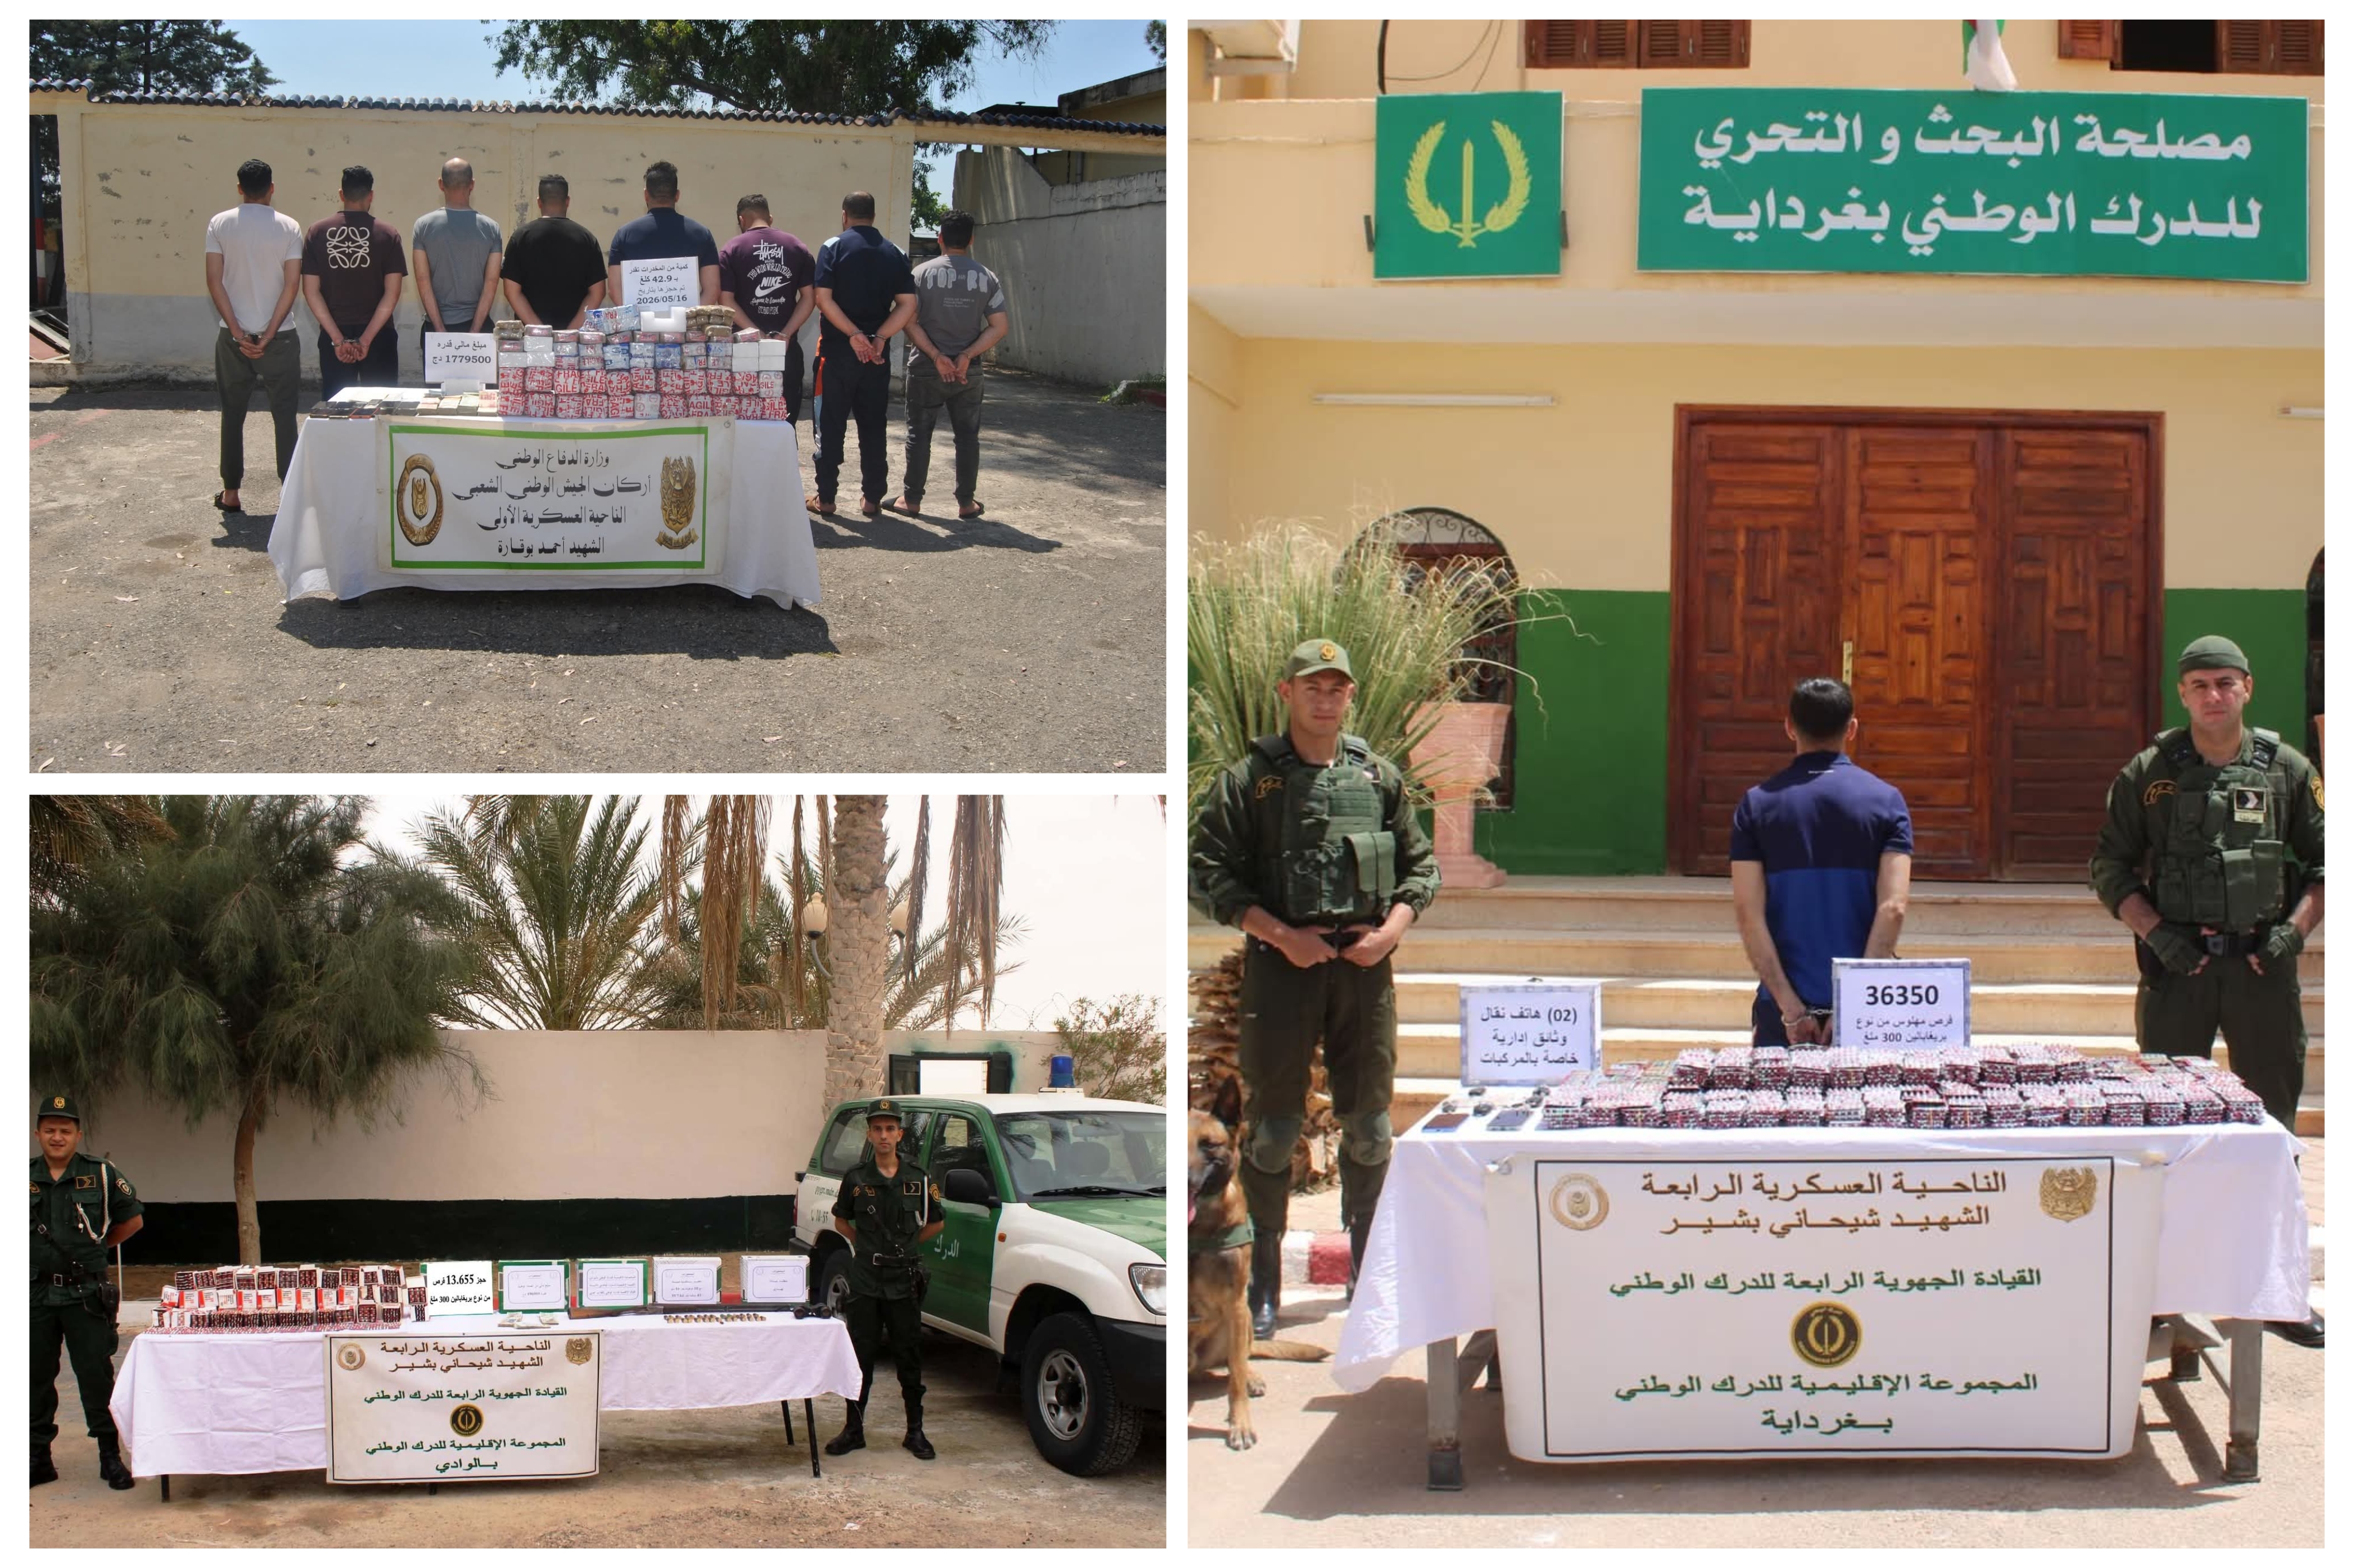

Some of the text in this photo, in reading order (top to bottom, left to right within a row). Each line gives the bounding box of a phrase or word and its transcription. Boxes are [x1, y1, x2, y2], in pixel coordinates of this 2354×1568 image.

[1695, 104, 2251, 169] مصلحة البحث و التحري
[1683, 186, 2262, 256] للدرك الوطني بغرداية
[640, 276, 650, 286] كلغ
[760, 276, 783, 287] NIKE
[636, 294, 687, 305] 2026/05/16
[638, 287, 656, 296] بتاريخ
[437, 340, 486, 350] مبلغ مالي قدره
[432, 355, 491, 364] 1779500 دج
[495, 448, 609, 473] وزارة الدفاع الوطني
[451, 476, 651, 501] أركان الجيش الوطني الشعبي
[476, 504, 626, 531] الناحية العسكرية الأولى
[498, 537, 604, 558] الشهيد أحمد بوقارة
[1865, 985, 1939, 1005] 36350
[1480, 1006, 1578, 1025] (02) هاتف نقال
[1856, 1016, 1874, 1030] نوع
[1877, 1017, 1890, 1028] من
[1929, 1015, 1953, 1027] قرص
[1882, 1033, 1902, 1043] 300
[1480, 1051, 1579, 1067] خاصة بالمركبات
[1641, 1170, 2006, 1202] الناحية العسكرية الرابعة
[1660, 1205, 1989, 1239] الشهيد شيحاني بشير
[934, 1234, 959, 1260] الدرك
[433, 1277, 445, 1285] قرص
[446, 1274, 474, 1285] 13.655
[1610, 1268, 2041, 1297] القيادة الجهوية الرابعة للدرك الوطني
[429, 1296, 438, 1304] ملغ
[473, 1295, 483, 1303] نوع
[380, 1339, 551, 1356] الناحية العسكرية الرابعة
[389, 1356, 543, 1373] الشهيد شيحاني بشير
[364, 1386, 567, 1404] القيادة الجهوية الرابعة للدرك الوطني
[1615, 1373, 2037, 1401] المجموعة الإقليمية للدرك الوطني
[1761, 1409, 1893, 1435] بغرداية
[366, 1437, 566, 1455] المجموعة الإقليمية للدرك الوطني
[436, 1457, 498, 1474] بالوادي
